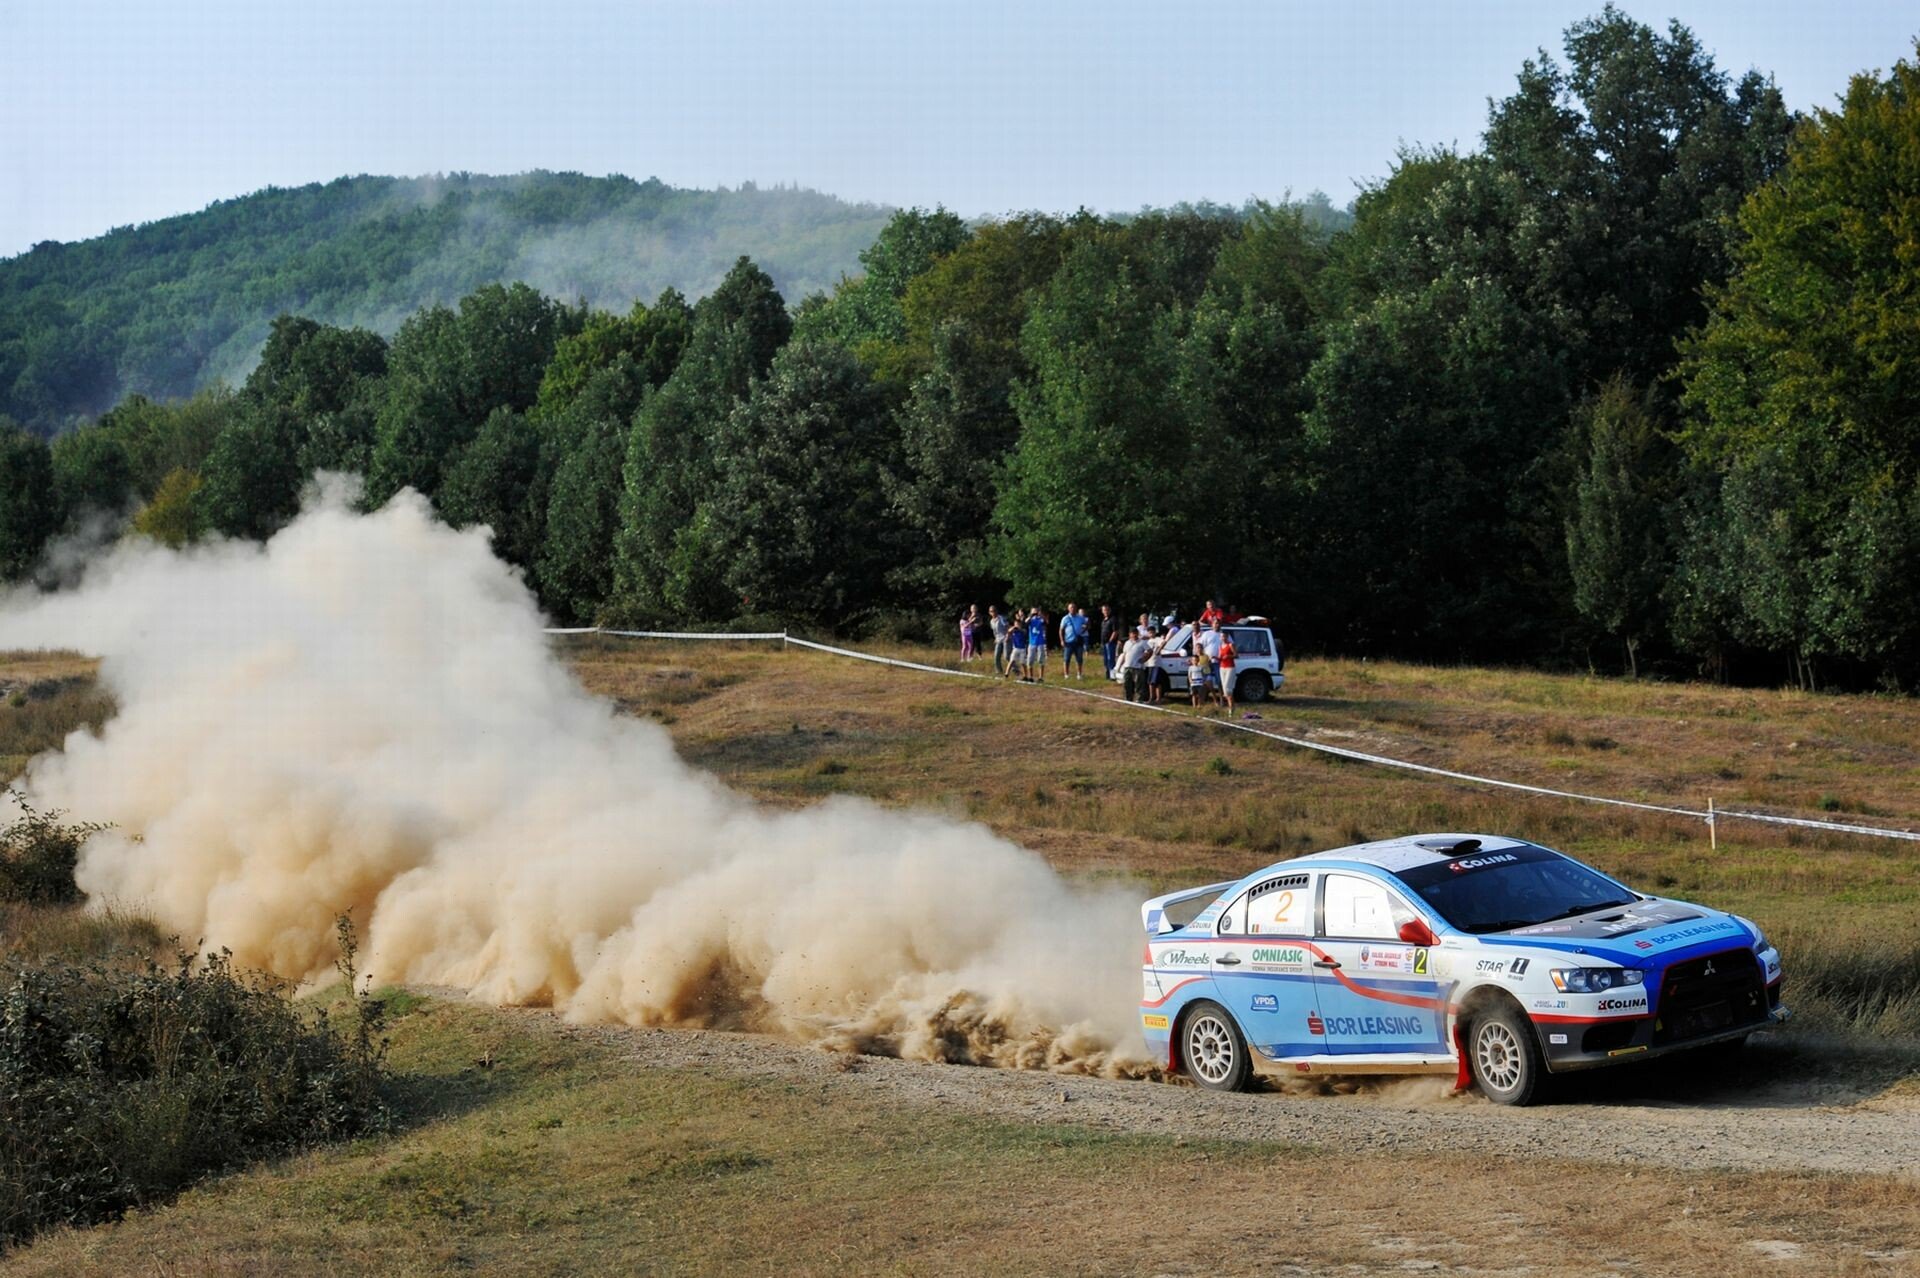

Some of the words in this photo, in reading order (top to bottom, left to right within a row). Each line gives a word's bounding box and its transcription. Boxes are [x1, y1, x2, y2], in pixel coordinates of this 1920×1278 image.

[1458, 853, 1518, 869] COLINA
[1274, 891, 1293, 922] 2
[1652, 932, 1681, 945] BCR
[1678, 921, 1734, 939] LEASING
[1169, 950, 1210, 965] Wheels
[1252, 949, 1303, 962] OMNIASIG
[1415, 948, 1427, 973] 2
[1476, 959, 1504, 973] STAR
[1607, 998, 1647, 1010] COLINA
[1325, 1017, 1358, 1036] BCR
[1359, 1016, 1423, 1035] LEASING
